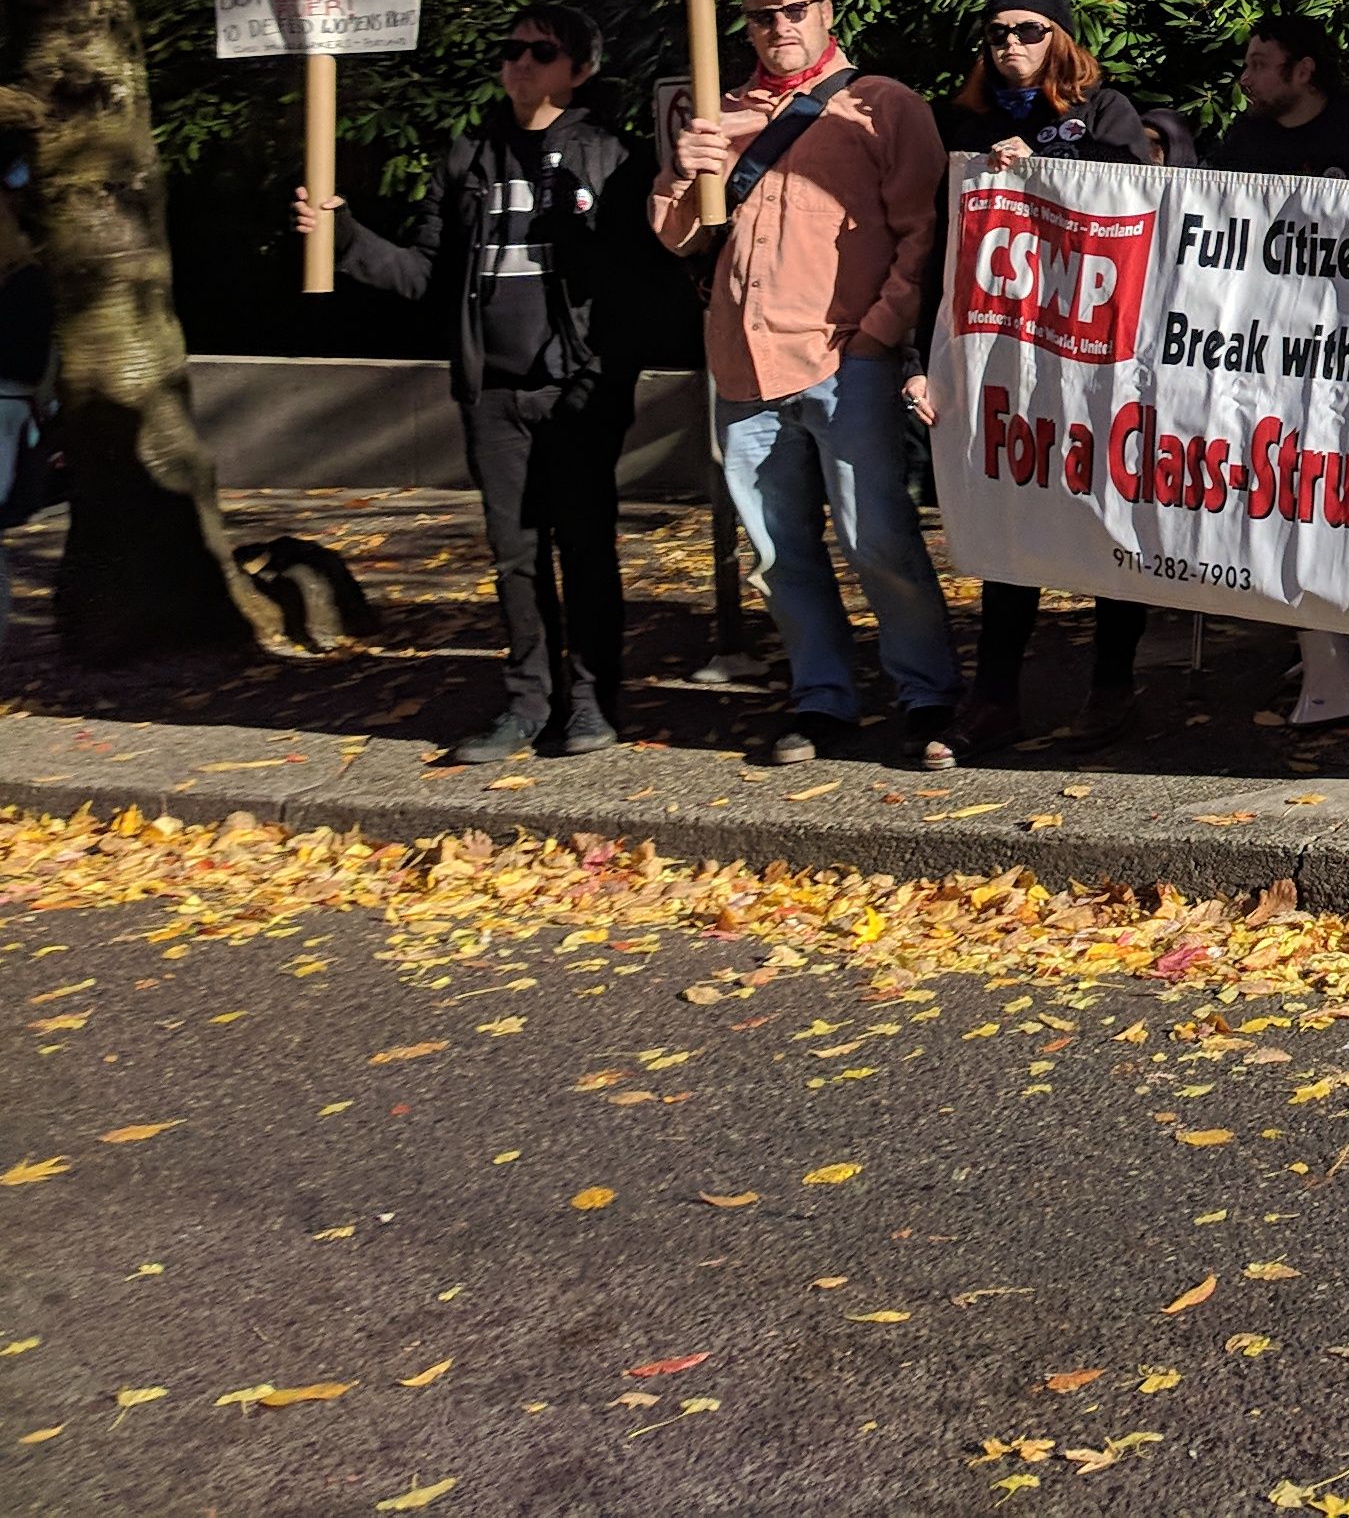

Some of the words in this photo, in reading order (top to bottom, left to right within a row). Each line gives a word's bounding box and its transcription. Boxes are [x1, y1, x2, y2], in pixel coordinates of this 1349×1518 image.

[1089, 219, 1145, 238] Portland
[1176, 212, 1251, 272] Full
[975, 226, 1118, 324] CSWP
[1161, 310, 1270, 375] Break
[983, 384, 1056, 490] For
[1063, 421, 1095, 497] a
[1112, 547, 1253, 592] 971-282-7903
